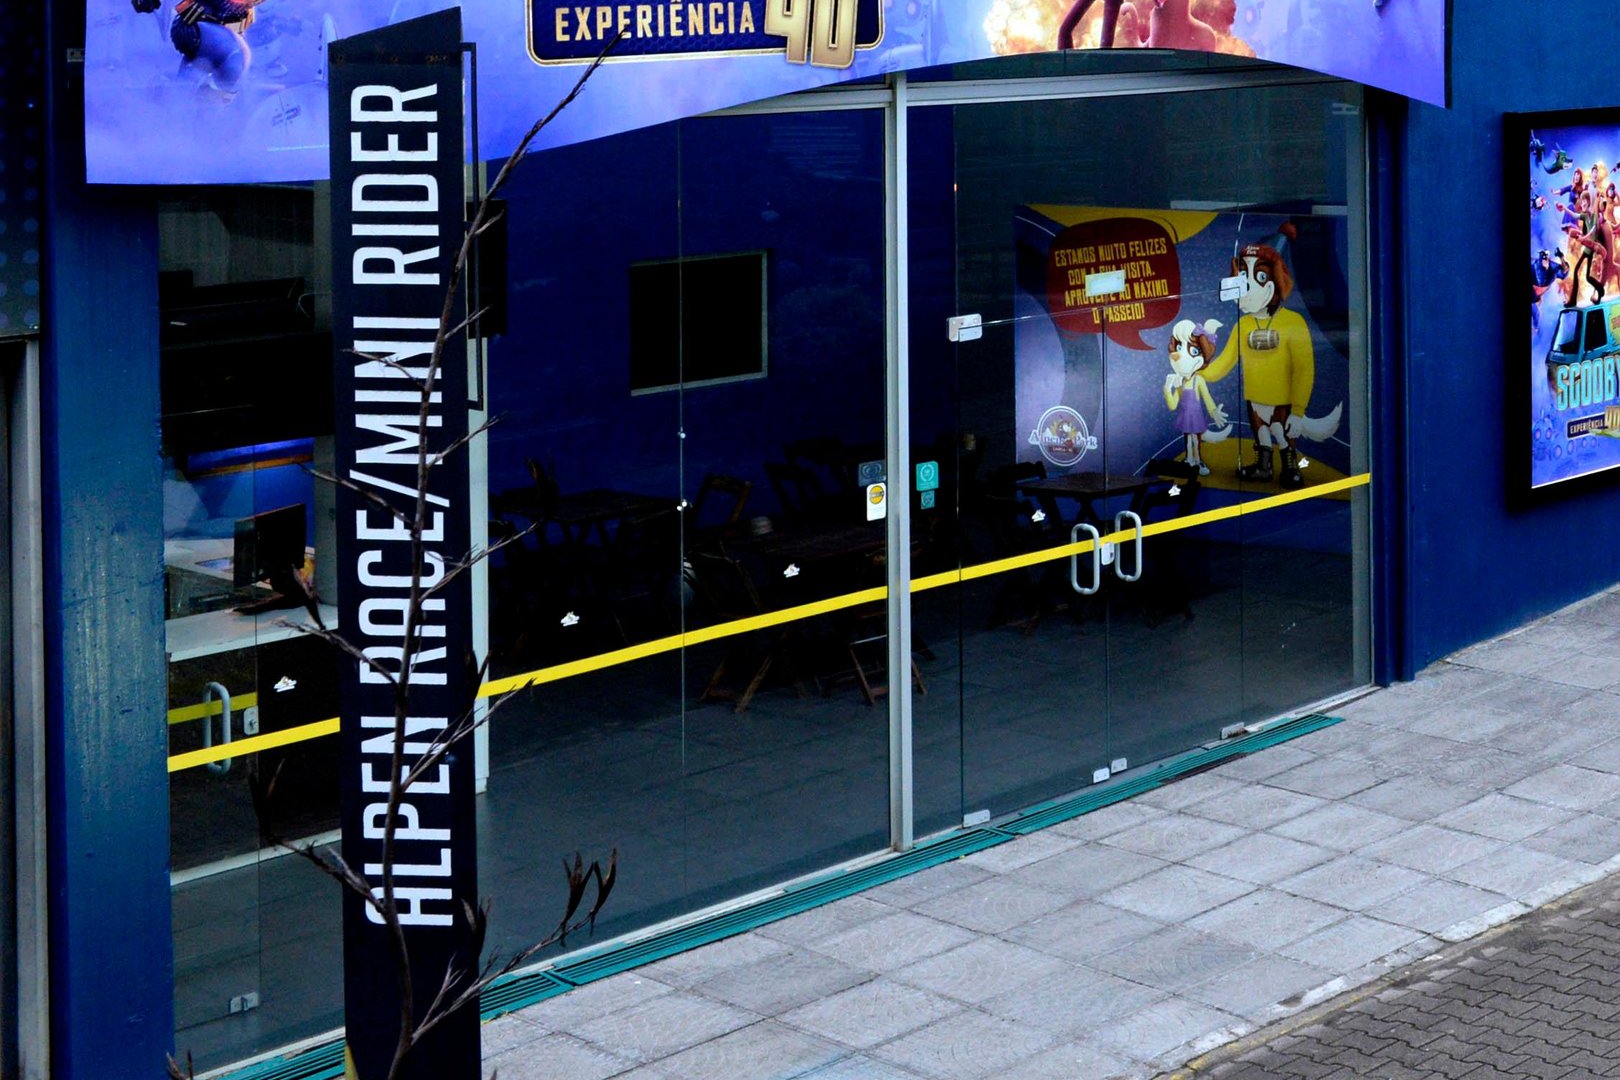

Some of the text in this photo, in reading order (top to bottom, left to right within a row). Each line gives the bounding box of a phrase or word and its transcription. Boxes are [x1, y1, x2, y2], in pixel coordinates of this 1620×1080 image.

[350, 82, 441, 286] RIDER
[1055, 237, 1168, 267] ESTAMOS MUITO FELIZES
[1133, 278, 1169, 299] MÁXIMO
[1092, 307, 1100, 324] O
[361, 716, 454, 927] ALPEN
